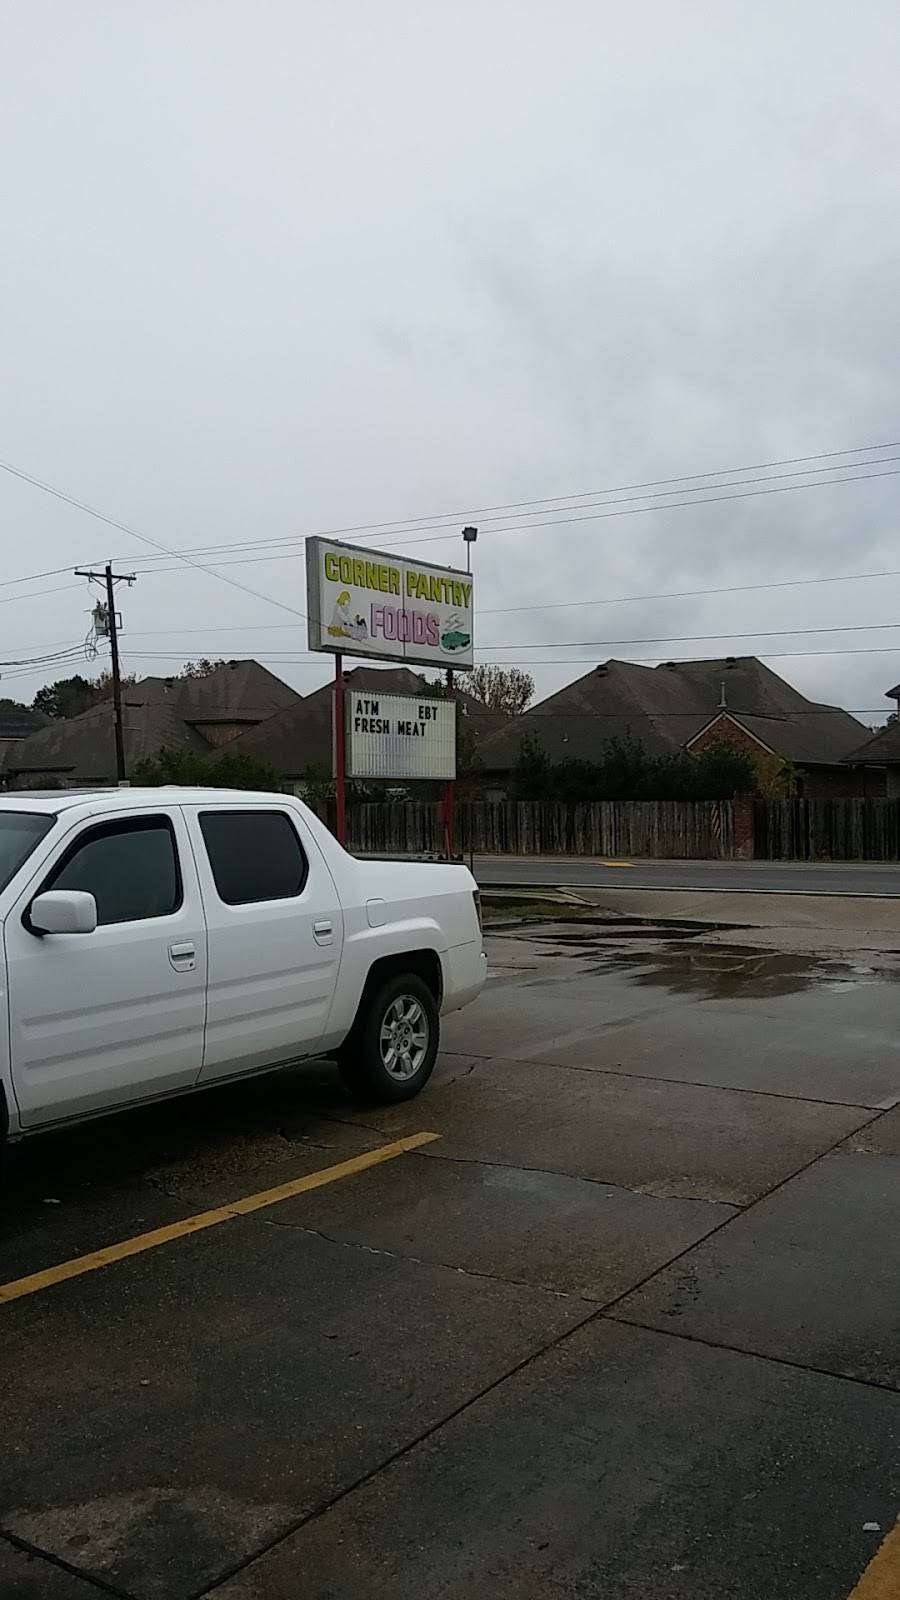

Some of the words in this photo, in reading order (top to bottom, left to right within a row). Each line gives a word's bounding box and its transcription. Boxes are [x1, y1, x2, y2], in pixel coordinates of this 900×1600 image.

[325, 552, 400, 595] CORNER
[406, 570, 473, 608] PANTRY
[371, 603, 440, 646] FOODS
[356, 699, 379, 716] ATM
[418, 705, 438, 721] EBT
[354, 717, 390, 734] FRESH
[397, 720, 426, 737] MEAT
